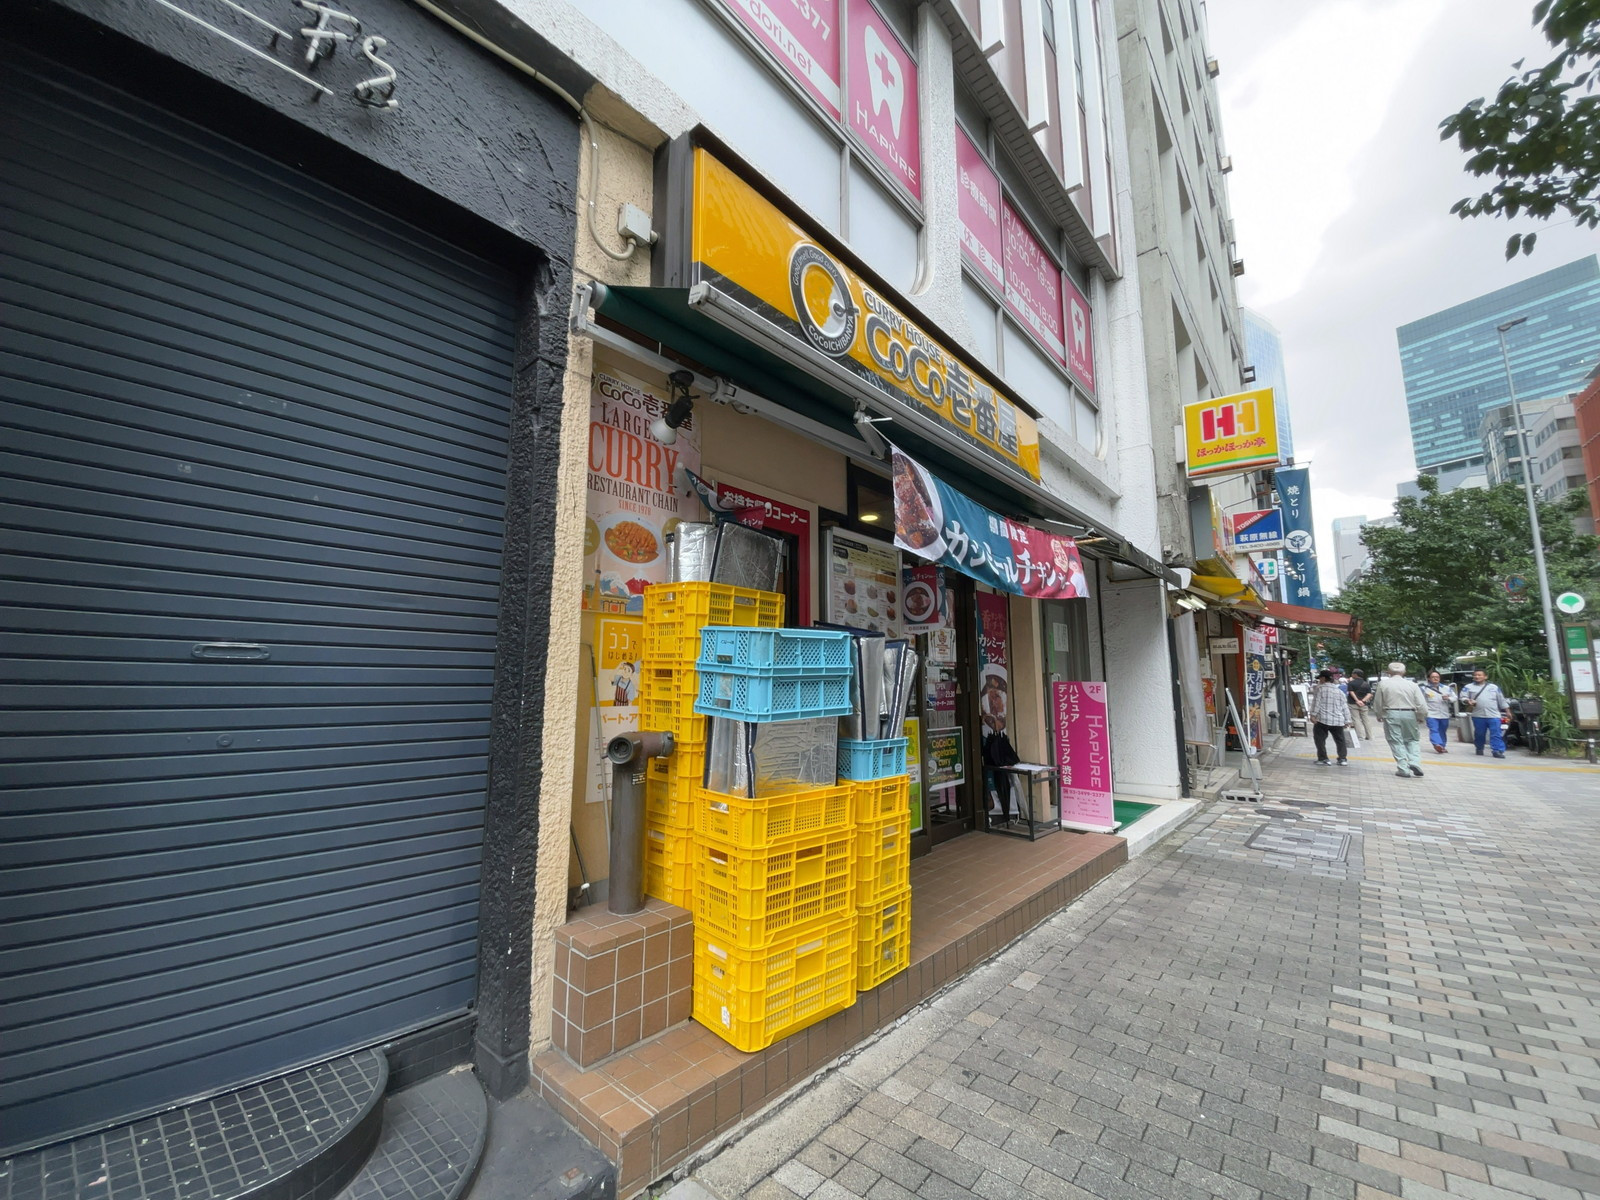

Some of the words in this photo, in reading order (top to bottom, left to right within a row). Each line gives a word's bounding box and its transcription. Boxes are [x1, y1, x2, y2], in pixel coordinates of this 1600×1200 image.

[790, 0, 831, 41] 377
[864, 290, 903, 333] CURRY
[905, 323, 942, 363] HOUSE
[599, 373, 620, 386] CURRY
[621, 382, 641, 396] HOUSE
[588, 420, 680, 496] CURRY
[1196, 437, 1266, 458] ほっかほっか亭
[587, 472, 651, 505] RESTAURANT
[652, 492, 679, 513] CHAIN
[618, 499, 637, 514] SINCE
[1287, 485, 1300, 520] 焼とり
[1236, 513, 1263, 530] TOSHIBA
[1069, 684, 1080, 723] ハピュア
[1088, 685, 1102, 695] 2F
